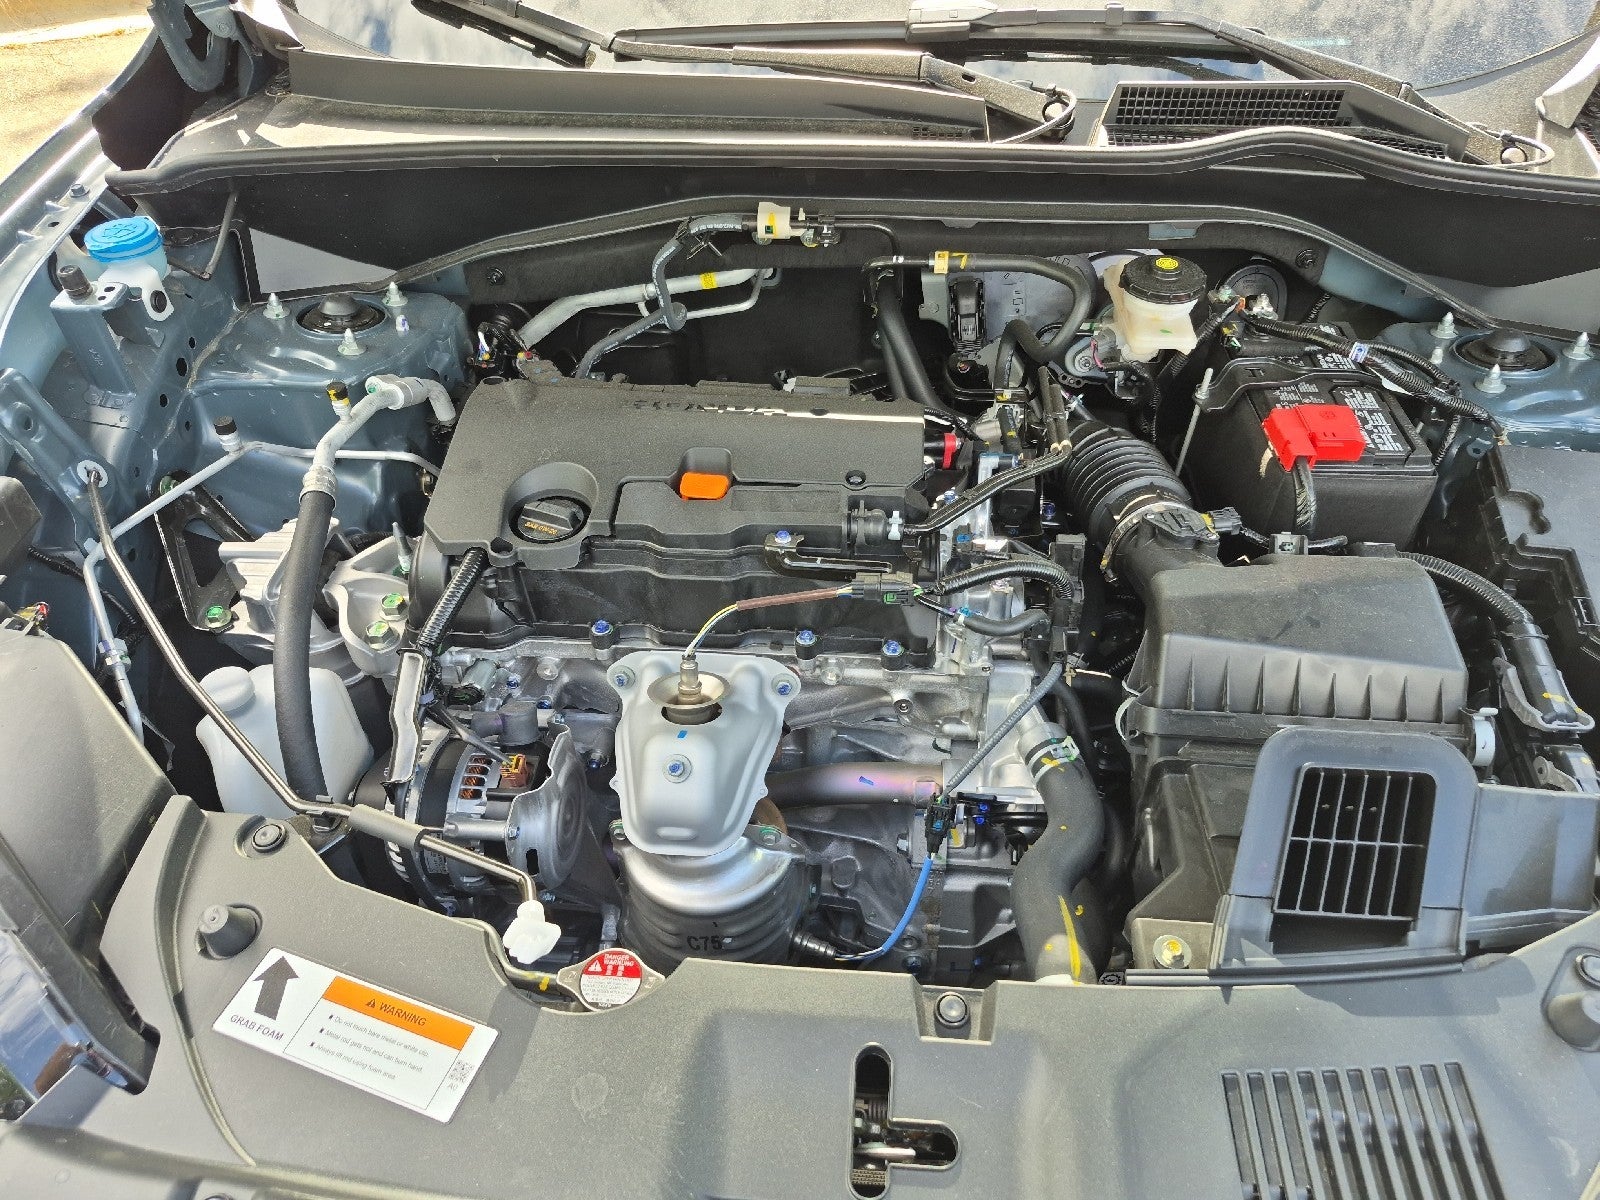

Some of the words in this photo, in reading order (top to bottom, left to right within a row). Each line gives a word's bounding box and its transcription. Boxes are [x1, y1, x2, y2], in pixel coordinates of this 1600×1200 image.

[603, 953, 630, 961] DANGER
[603, 959, 634, 967] WARNING
[230, 1014, 256, 1031] GRAB
[256, 1024, 284, 1041] FOAM
[379, 1002, 427, 1027] WARNING
[325, 1030, 341, 1039] Metal
[340, 1036, 351, 1044] rod
[349, 1040, 363, 1049] gets
[395, 1057, 408, 1066] burn
[352, 1023, 368, 1033] touch
[368, 1030, 380, 1038] bare
[403, 1043, 418, 1052] white
[315, 1044, 336, 1056] Always
[352, 1059, 368, 1069] using
[368, 1065, 383, 1074] foam
